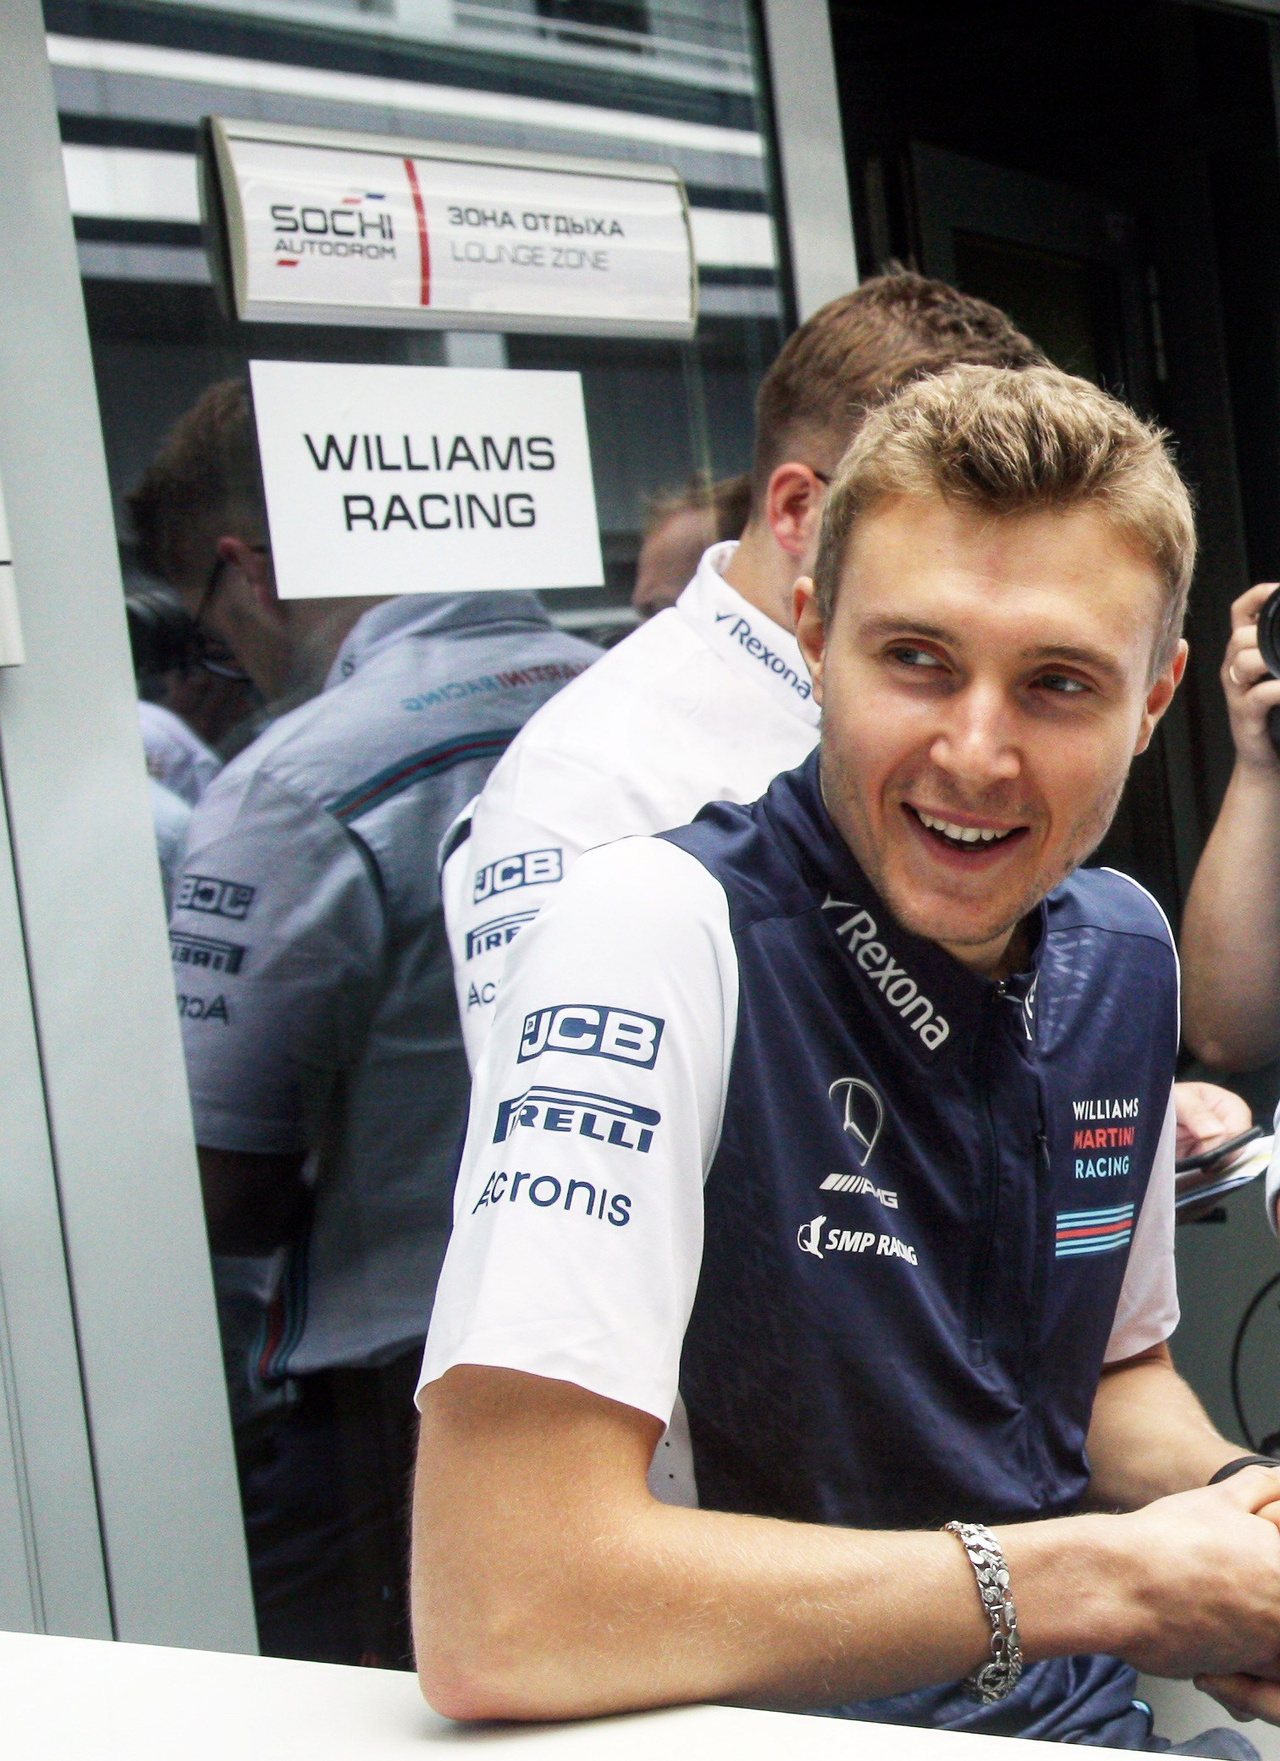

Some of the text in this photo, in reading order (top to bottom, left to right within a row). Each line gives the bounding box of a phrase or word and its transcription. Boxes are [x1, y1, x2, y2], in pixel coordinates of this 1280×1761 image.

[271, 205, 394, 239] SOCHI
[448, 206, 625, 237] ЗОНА ОТДЫХА
[274, 237, 397, 259] AUTODROM
[451, 240, 609, 271] LOUNGE ZONE
[304, 433, 555, 471] WILLIAMS
[343, 493, 536, 531] RACING
[729, 617, 812, 700] Rexona
[474, 849, 563, 904] JCB
[836, 910, 950, 1050] Rexona
[519, 1005, 661, 1067] JCB
[1072, 1097, 1139, 1120] WILLIAMS
[1073, 1126, 1135, 1150] MARTINI
[1075, 1155, 1130, 1179] RACING
[472, 1171, 632, 1226] Acronis
[825, 1229, 875, 1253] SMP
